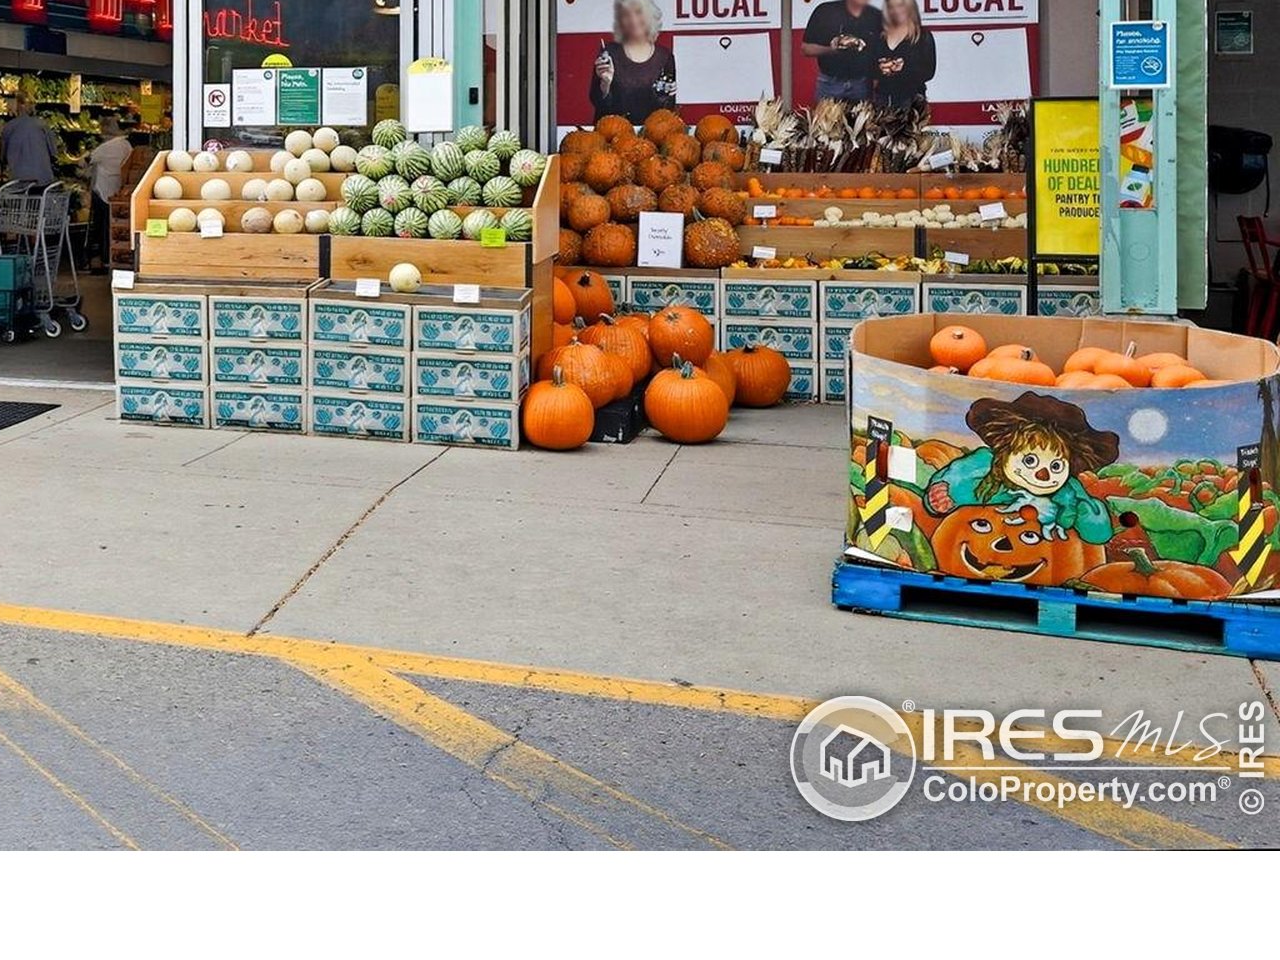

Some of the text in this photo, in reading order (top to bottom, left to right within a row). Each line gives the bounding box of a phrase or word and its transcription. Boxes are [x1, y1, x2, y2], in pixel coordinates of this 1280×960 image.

[1047, 175, 1100, 191] OF DEAL
[1055, 193, 1089, 205] PANTRY
[1059, 206, 1100, 218] PRODUCE
